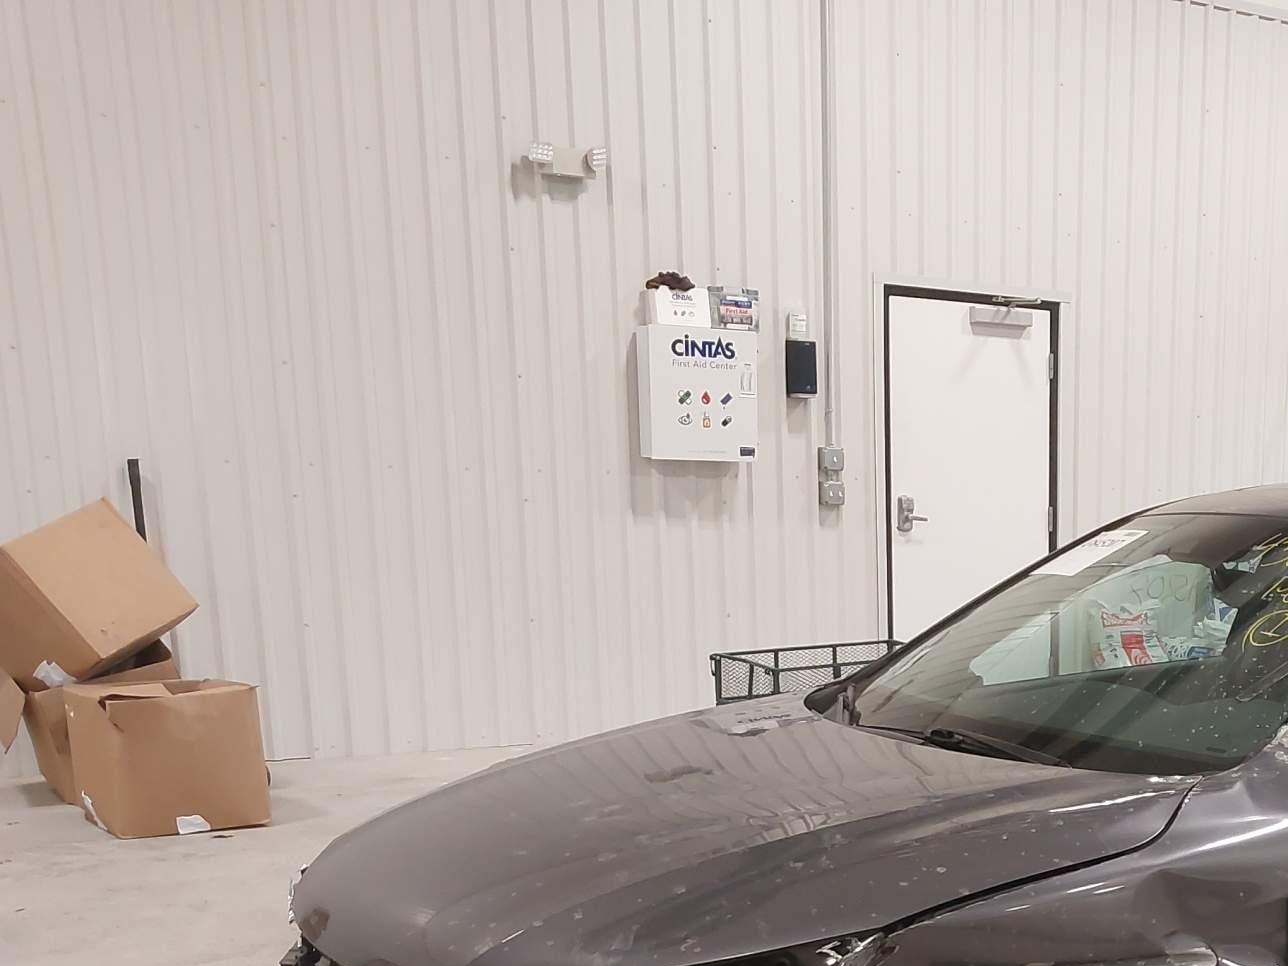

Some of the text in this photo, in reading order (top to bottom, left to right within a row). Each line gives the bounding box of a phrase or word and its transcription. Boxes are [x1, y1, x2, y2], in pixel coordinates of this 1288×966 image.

[672, 359, 737, 370] First Aid Center
